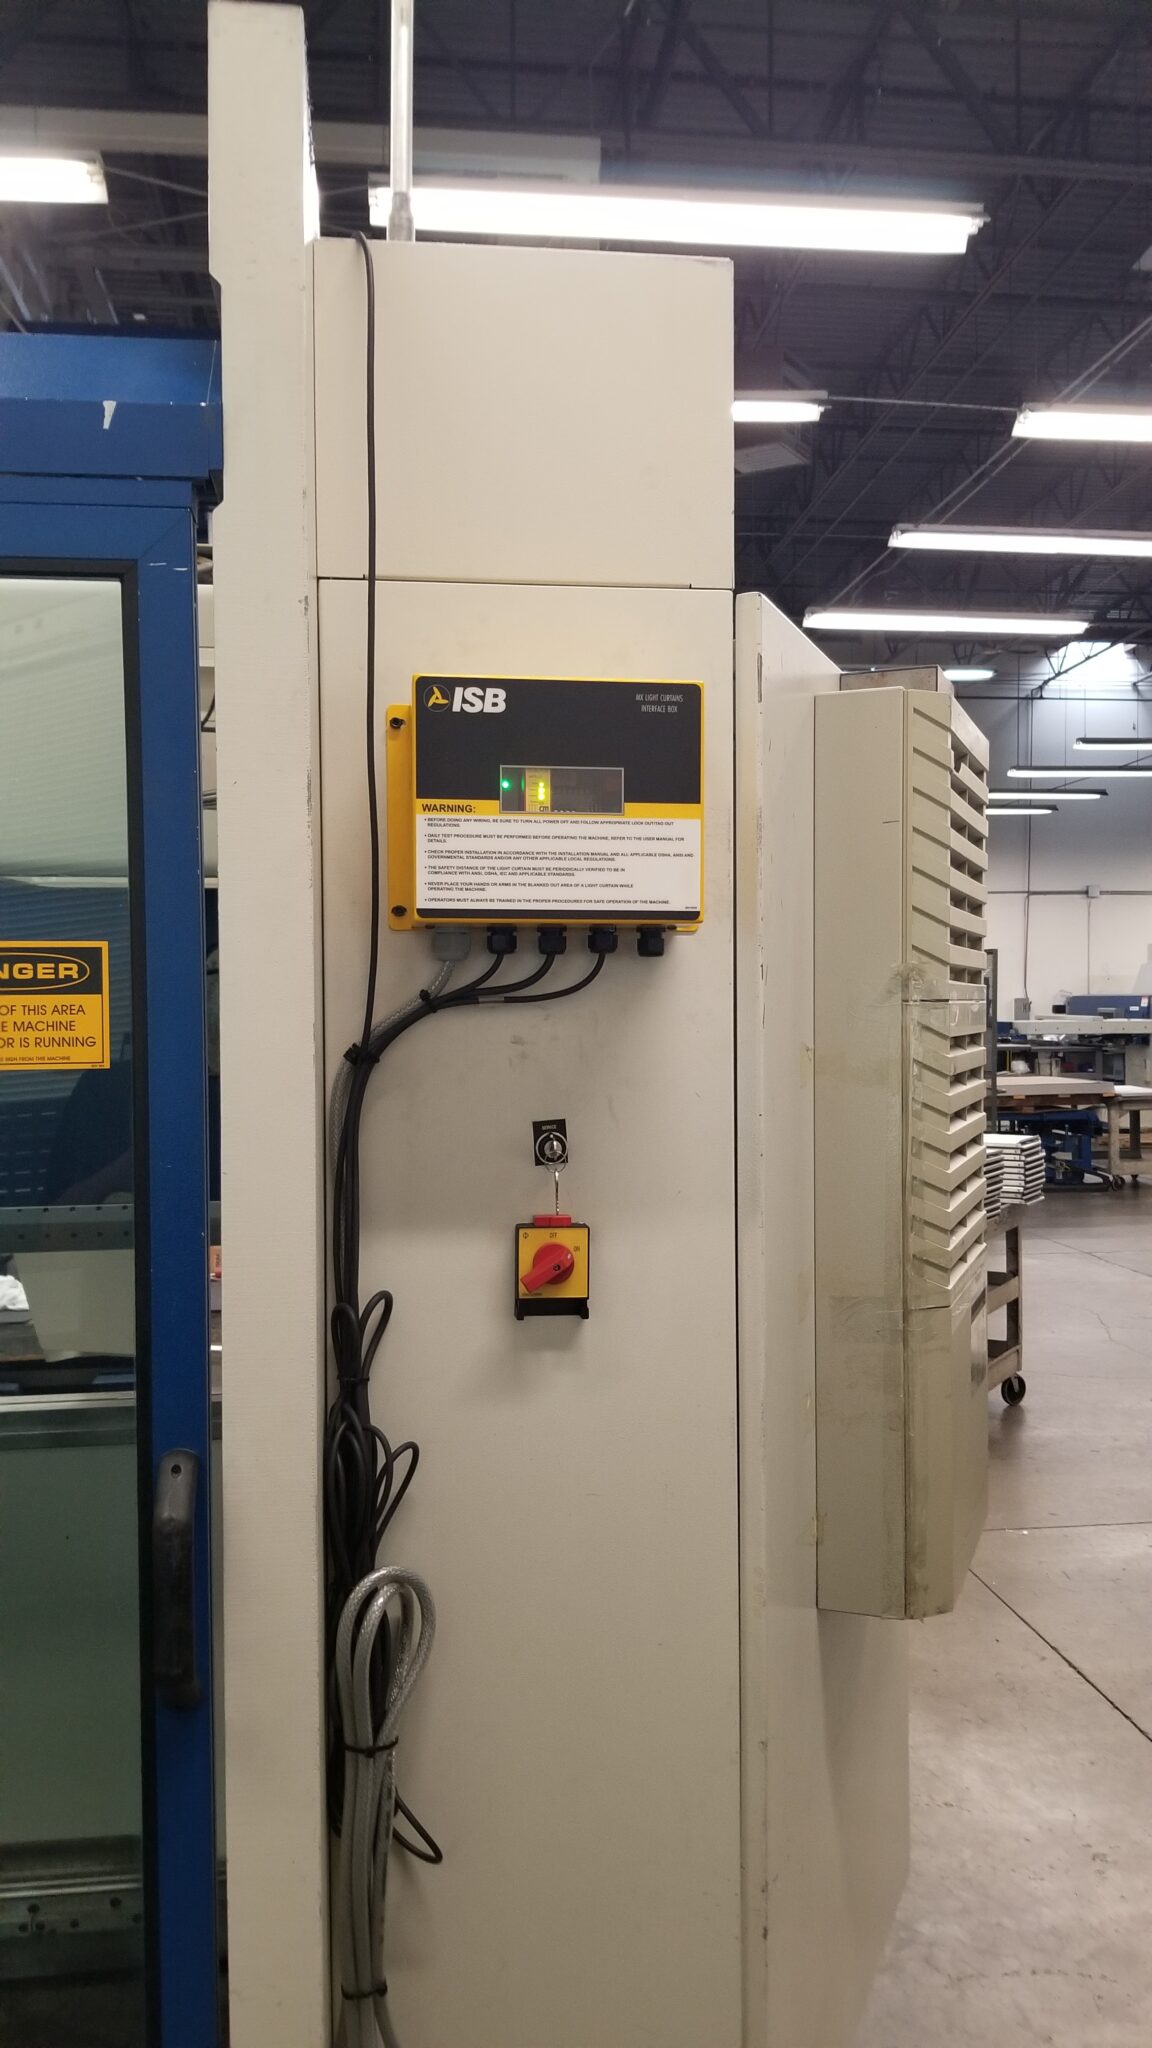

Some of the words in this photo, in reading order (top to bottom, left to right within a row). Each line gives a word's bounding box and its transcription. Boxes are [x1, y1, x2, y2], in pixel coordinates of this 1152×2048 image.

[452, 686, 507, 714] ISB
[660, 694, 684, 702] CURTAINS
[641, 704, 666, 712] INTERFACE
[422, 804, 476, 813] WARNING:
[0, 1004, 16, 1016] OF
[21, 1004, 47, 1016] THIS
[51, 1004, 86, 1015] AREA
[14, 1020, 76, 1032] MACHINE
[20, 1037, 30, 1048] IS
[35, 1036, 96, 1048] RUNNING
